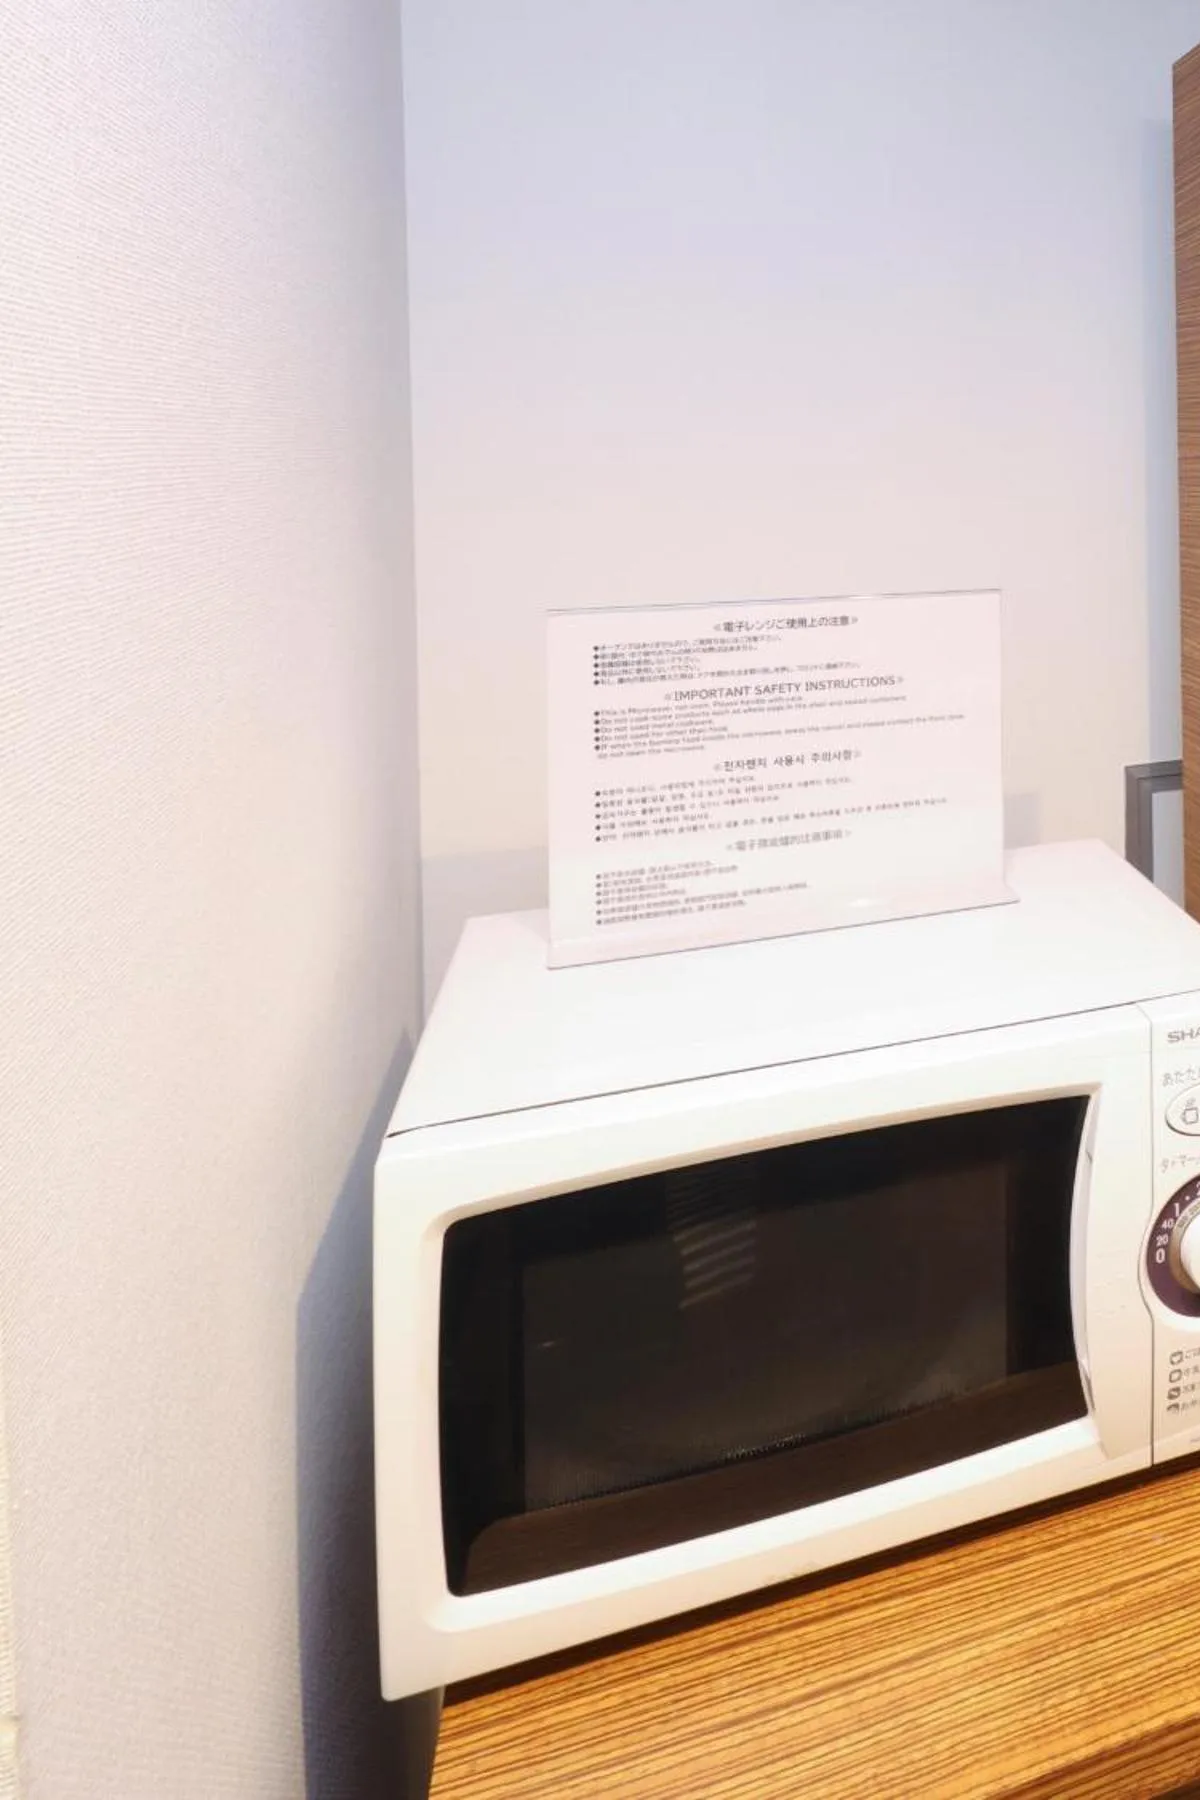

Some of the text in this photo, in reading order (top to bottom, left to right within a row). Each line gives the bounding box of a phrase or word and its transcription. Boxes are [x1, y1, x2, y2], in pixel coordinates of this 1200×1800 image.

[675, 675, 896, 701] IMPORTANT SAFETY INSTRUCTIONS
[1174, 1203, 1180, 1217] 1
[1162, 1218, 1174, 1230] 40
[1156, 1248, 1166, 1264] 0
